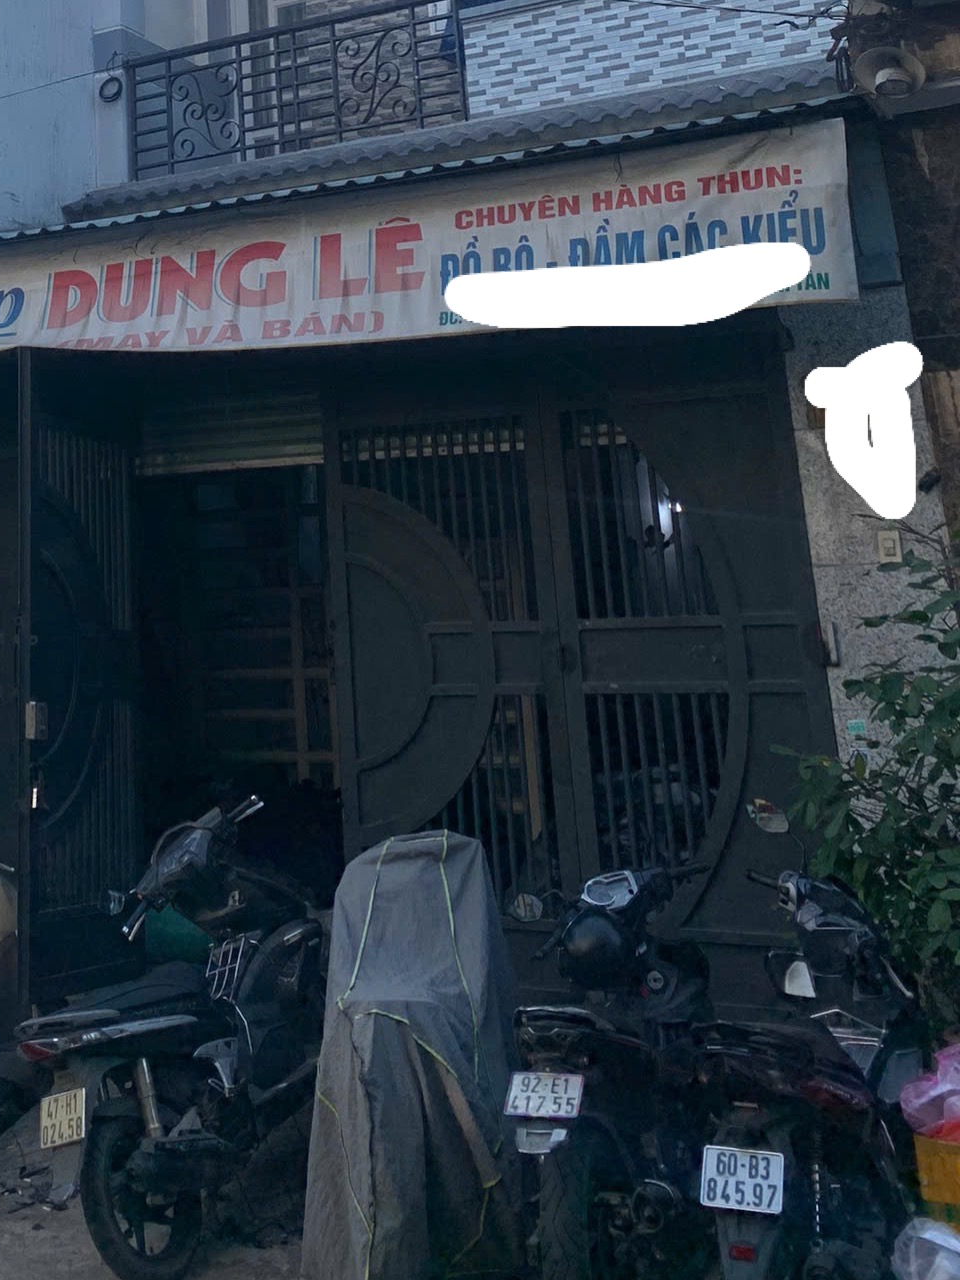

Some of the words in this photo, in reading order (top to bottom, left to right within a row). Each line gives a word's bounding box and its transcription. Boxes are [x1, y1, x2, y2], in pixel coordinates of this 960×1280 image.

[454, 195, 581, 230] CHUYÊN
[592, 184, 687, 212] HÀNG
[697, 165, 803, 196] THUN:
[41, 240, 288, 330] DUNG
[312, 216, 426, 301] LÊ
[186, 319, 244, 345] VÀ
[261, 310, 385, 338] BÁN)
[520, 1076, 570, 1095] 92-E1
[47, 1093, 78, 1120] 47-H1
[510, 1095, 577, 1114] 417.55
[42, 1116, 82, 1146] 024.58
[716, 1152, 771, 1180] 60-B3
[706, 1177, 778, 1209] 845.97
